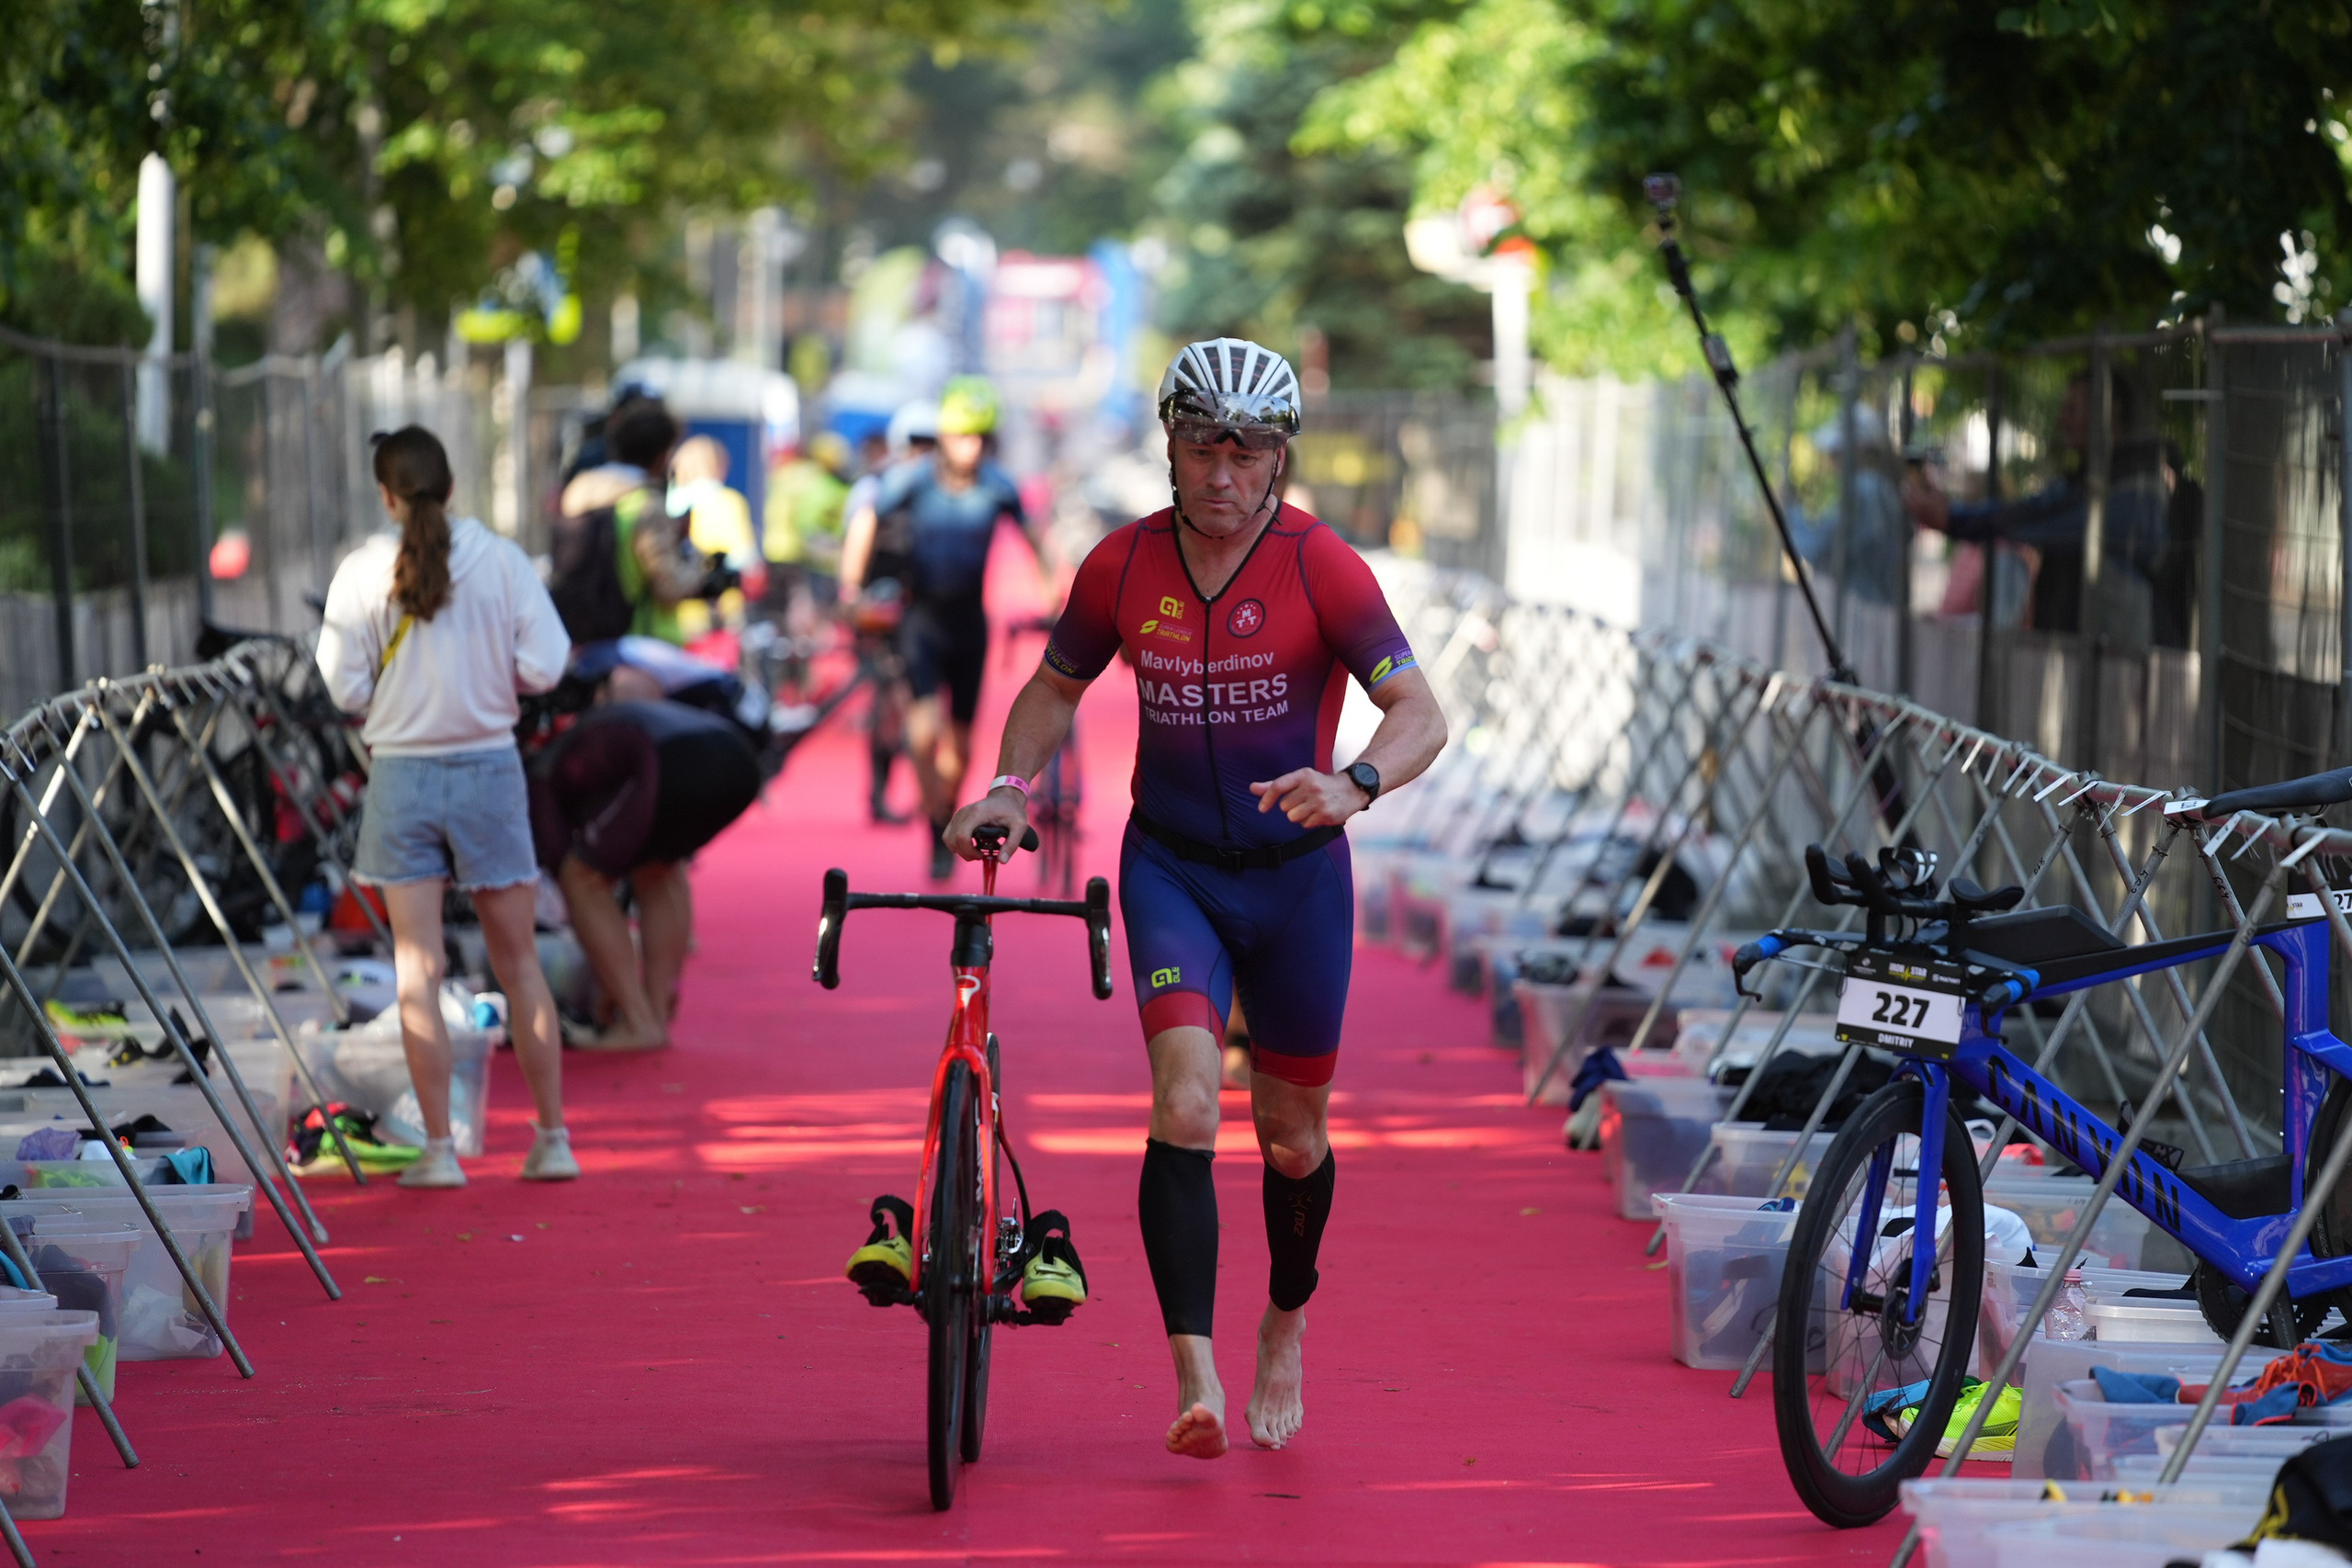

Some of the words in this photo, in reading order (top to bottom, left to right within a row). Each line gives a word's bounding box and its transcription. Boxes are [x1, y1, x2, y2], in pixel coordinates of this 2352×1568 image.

[1156, 628, 1191, 642] TRIATHLON
[1141, 649, 1274, 677] Mavlyberdinov
[1138, 672, 1288, 707] MASTERS
[1144, 705, 1237, 726] TRIATHLON
[1240, 699, 1289, 723] TEAM
[1888, 962, 1905, 974] IRON
[1910, 965, 1928, 977] STAR
[1871, 991, 1930, 1029] 227
[1877, 1032, 1915, 1049] DMITRIY
[1988, 1055, 2181, 1233] CANYON
